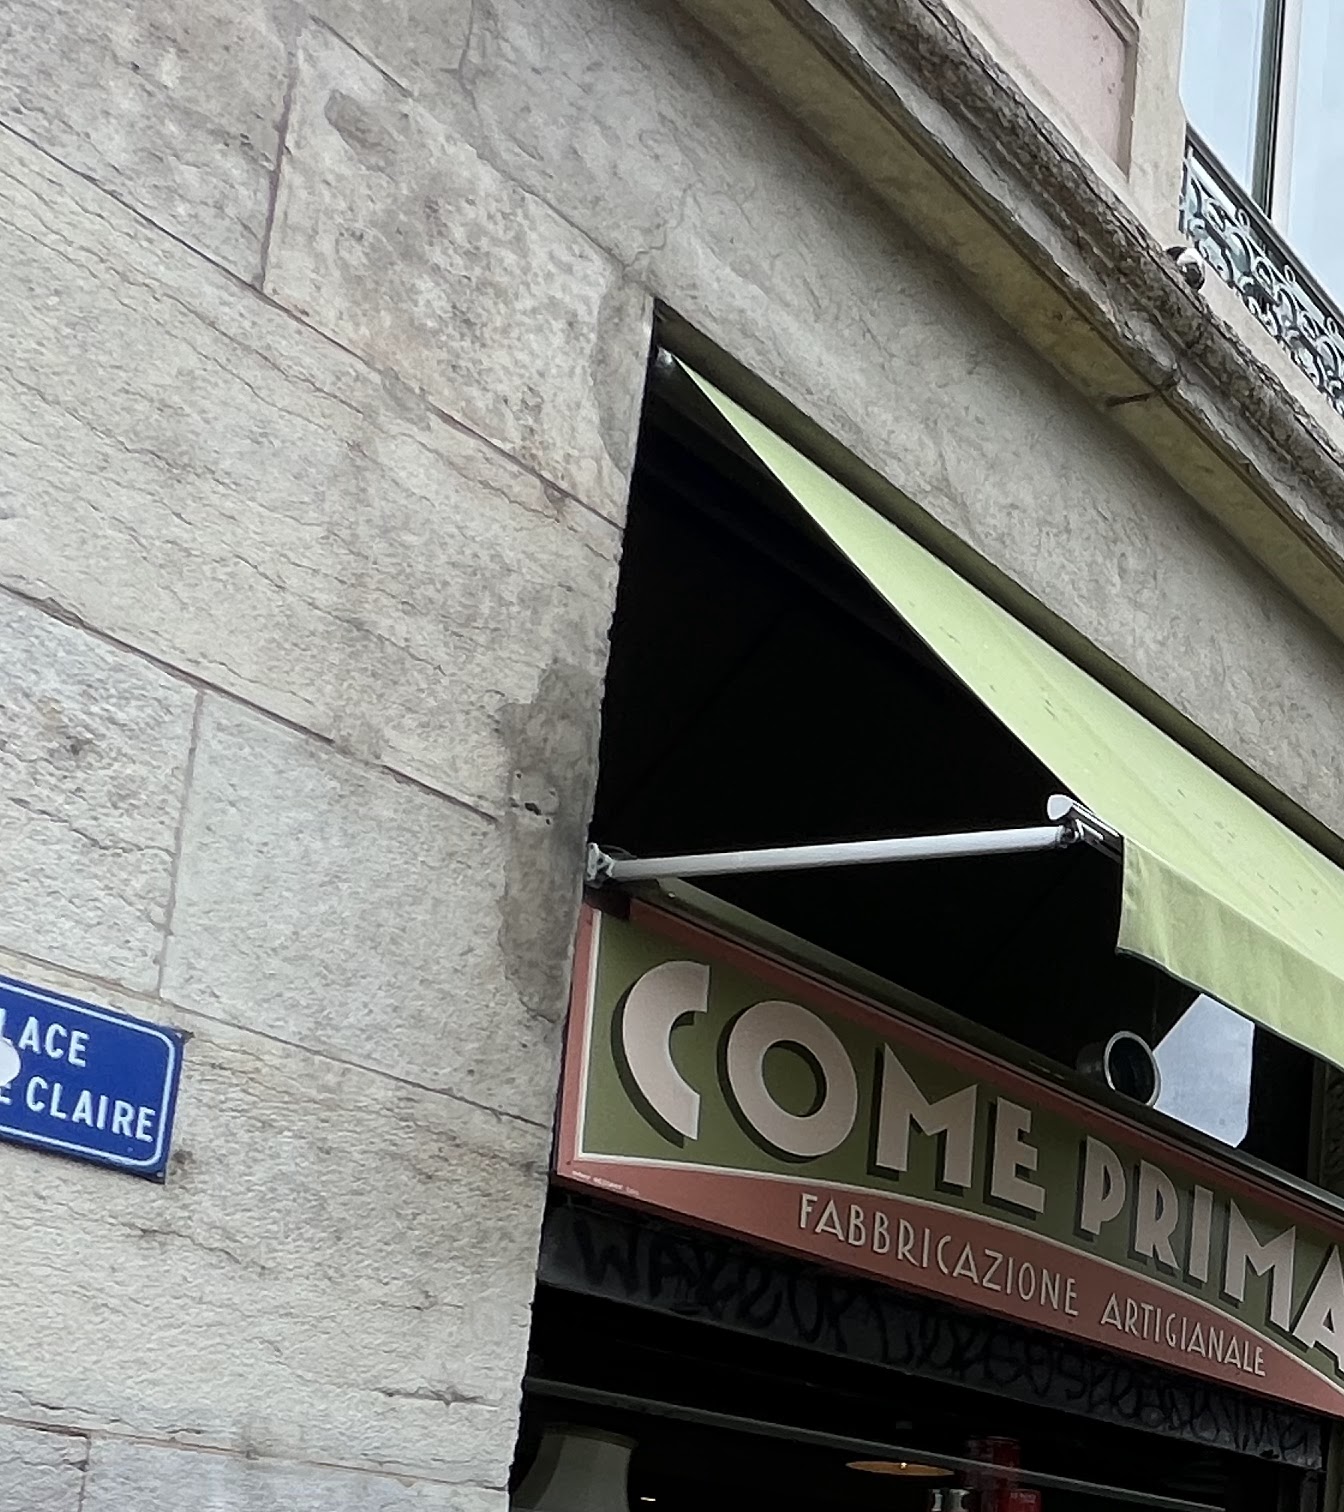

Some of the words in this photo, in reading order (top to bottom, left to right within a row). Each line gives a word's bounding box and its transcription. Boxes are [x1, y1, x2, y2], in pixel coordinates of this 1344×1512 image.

[26, 1076, 156, 1143] CLAIRE
[613, 960, 1047, 1214] COME
[799, 1193, 1079, 1318] FABBRICAZIONE
[1100, 1291, 1266, 1379] ARTIGIANALE
